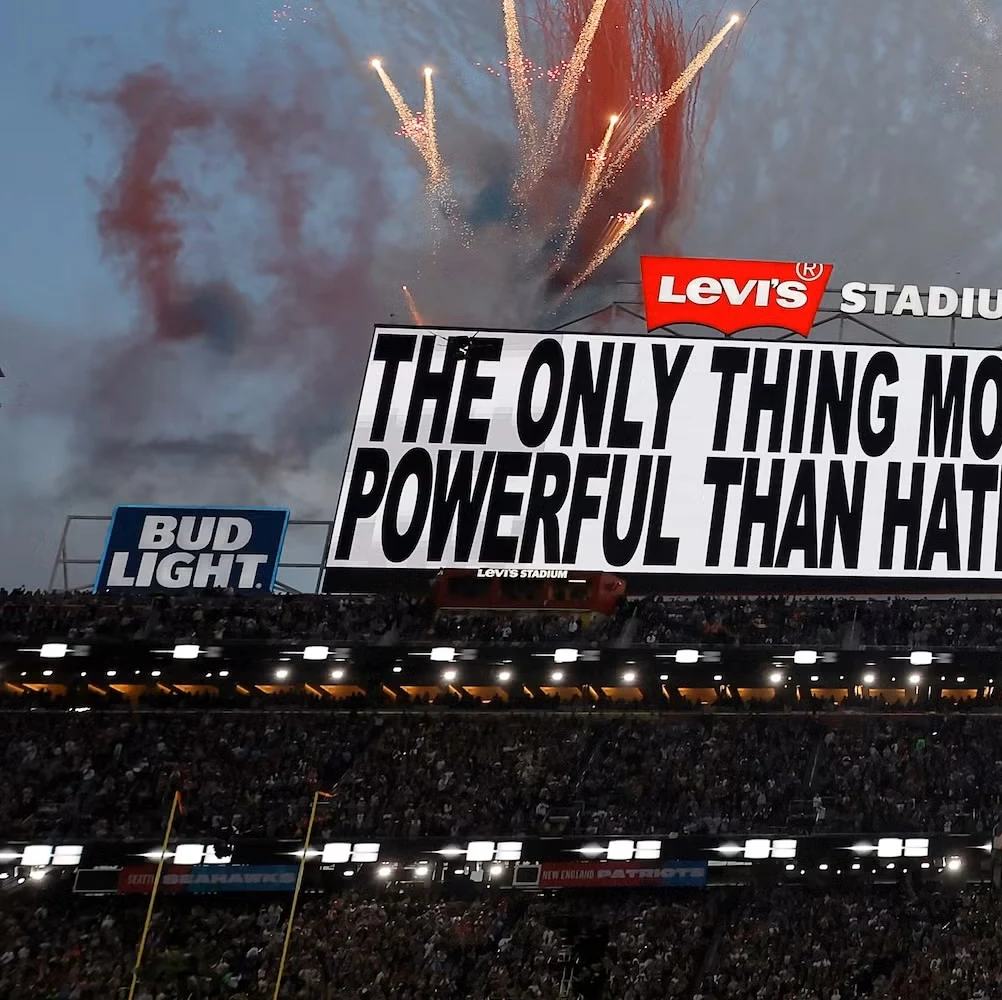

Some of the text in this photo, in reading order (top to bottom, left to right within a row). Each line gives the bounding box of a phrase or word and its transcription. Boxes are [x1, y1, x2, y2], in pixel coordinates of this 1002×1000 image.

[370, 334, 504, 445] THE
[517, 338, 694, 450] ONLY
[711, 346, 899, 458] THING
[334, 447, 680, 567] POWERFUL
[704, 457, 867, 570] THAN
[138, 515, 253, 551] BUD
[106, 552, 269, 589] LIGHT
[519, 569, 569, 579] STADIUM
[541, 867, 705, 880] NEW ENGLAND PATRIOTS
